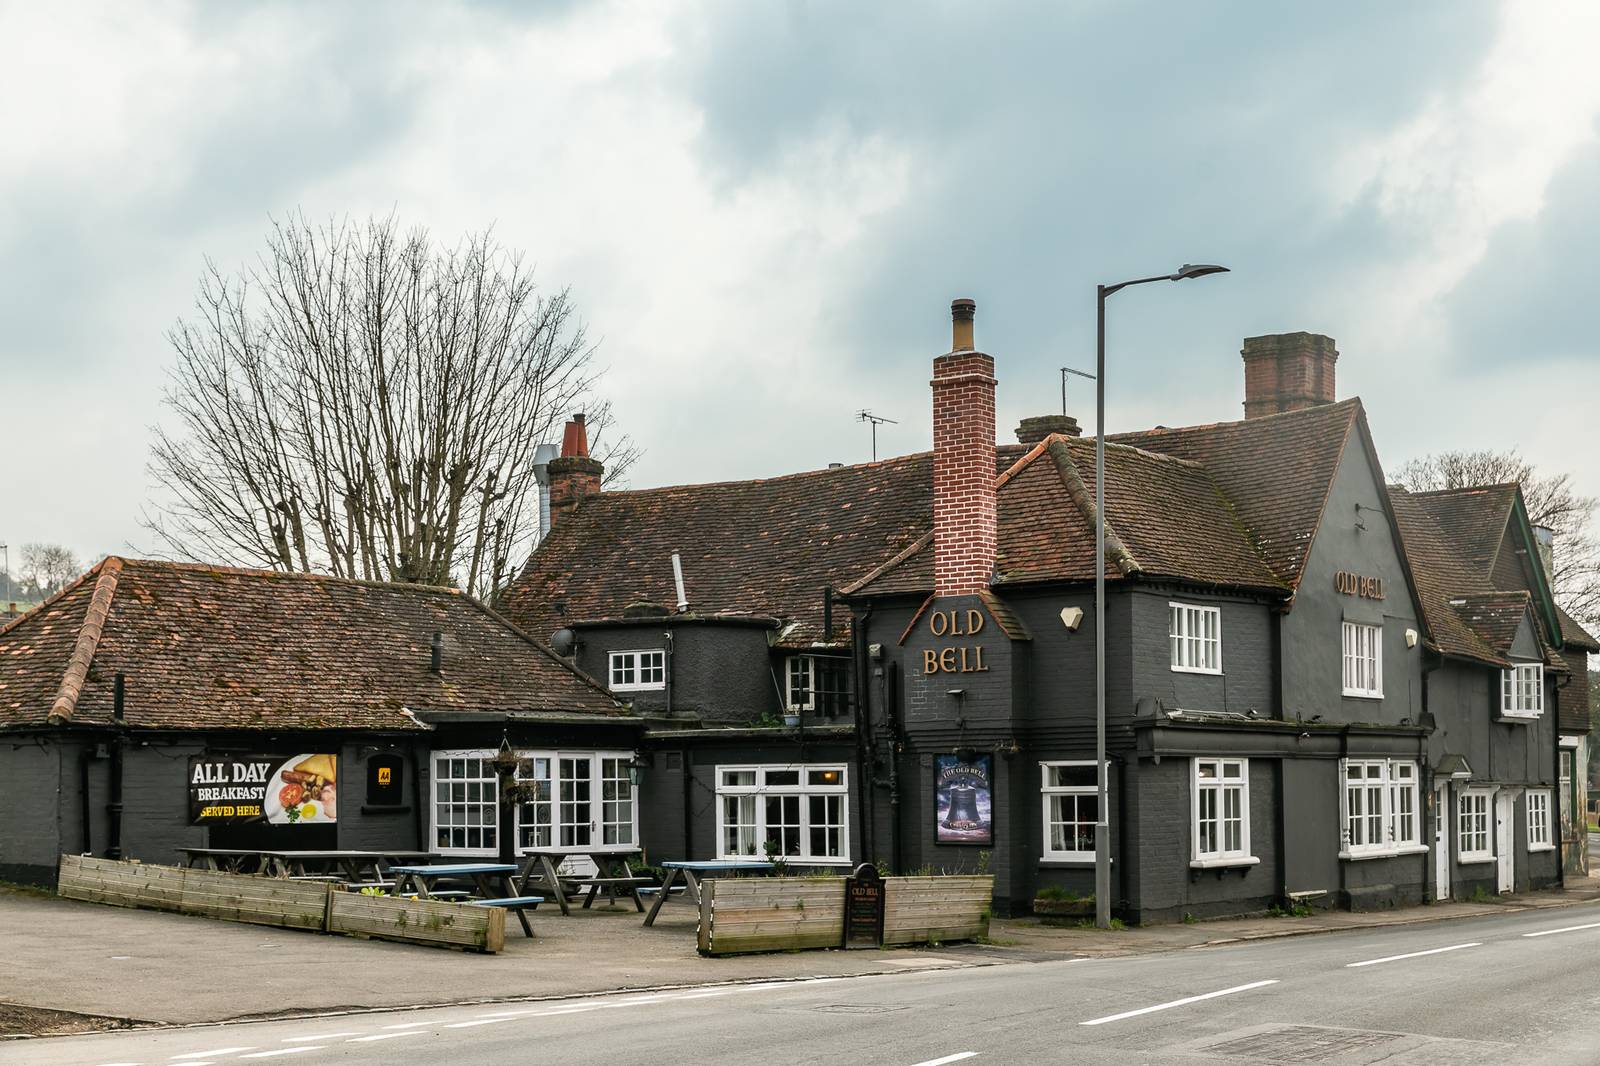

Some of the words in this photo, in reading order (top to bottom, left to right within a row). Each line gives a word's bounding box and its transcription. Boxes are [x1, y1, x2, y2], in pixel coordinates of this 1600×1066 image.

[1335, 570, 1357, 594] OLD
[1360, 576, 1386, 599] BELL
[930, 609, 984, 636] OLD
[923, 646, 989, 674] BELL
[192, 763, 229, 784] ALL
[233, 763, 271, 783] DAY
[943, 768, 956, 779] THE
[970, 768, 986, 779] BELL
[197, 787, 265, 801] BREAKFAST
[200, 806, 235, 817] SERVED
[236, 805, 260, 816] HERE
[852, 887, 866, 896] OLD
[866, 887, 879, 896] BELL
